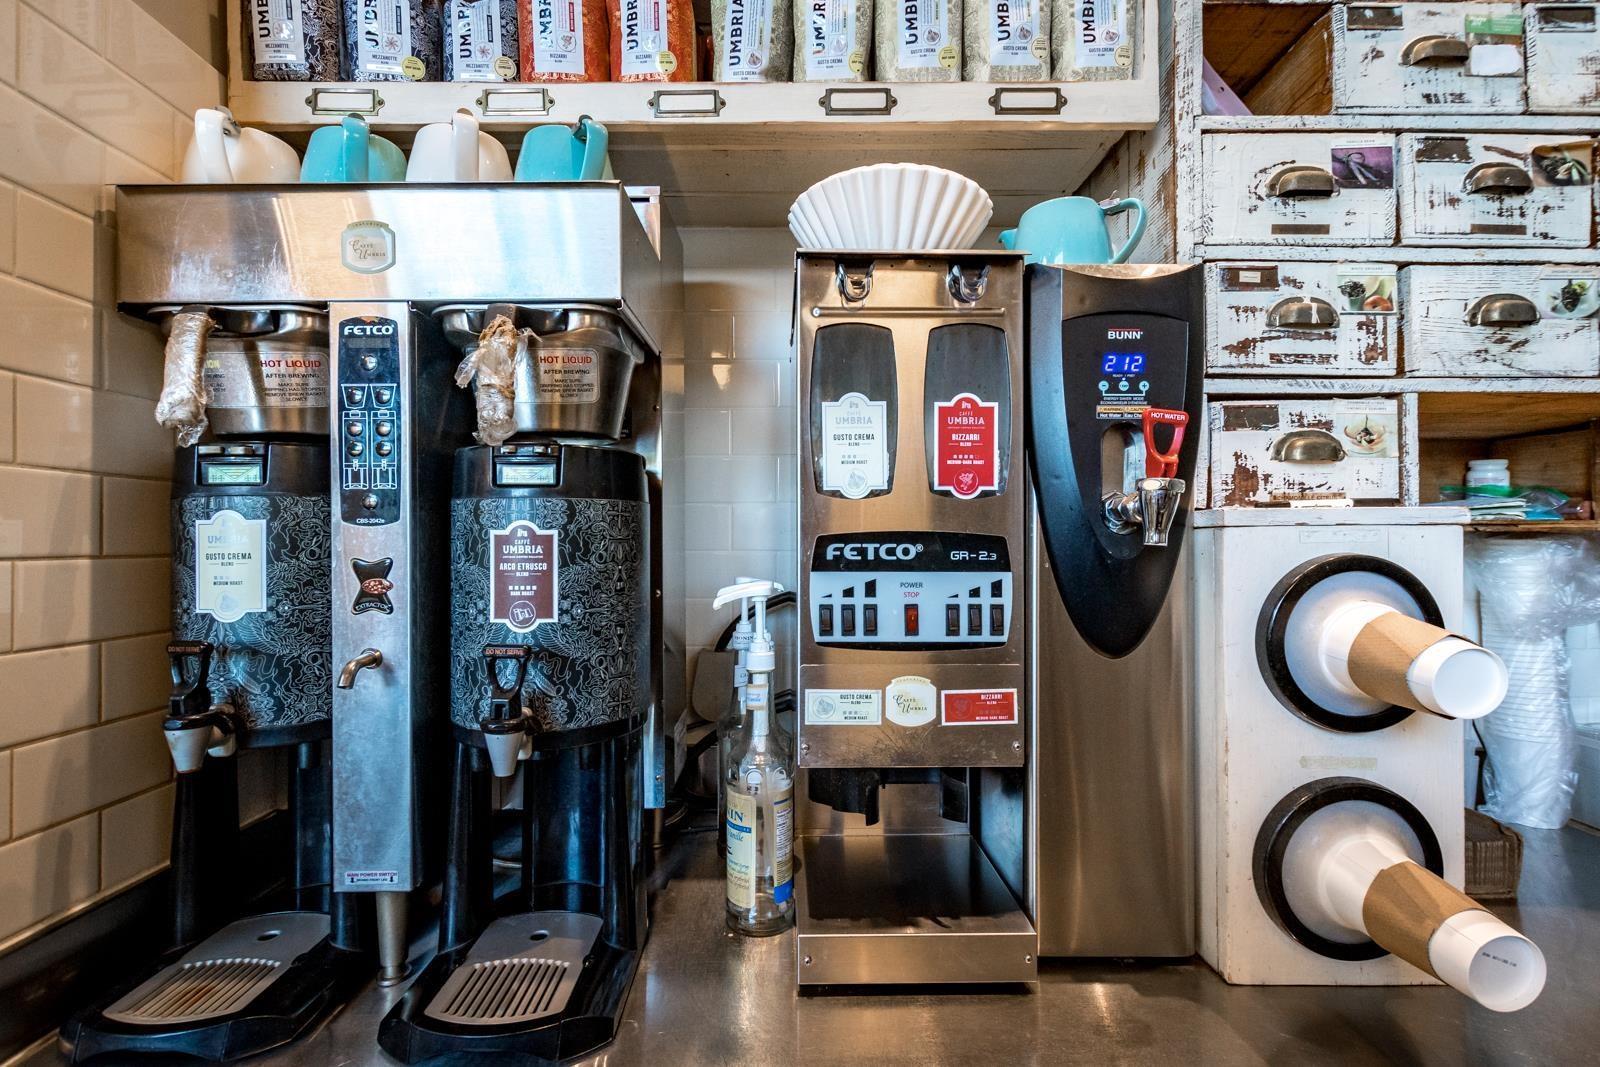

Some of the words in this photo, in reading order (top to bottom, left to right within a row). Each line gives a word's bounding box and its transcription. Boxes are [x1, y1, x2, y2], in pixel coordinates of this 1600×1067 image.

[260, 360, 283, 368] HOT
[285, 360, 321, 368] LIQUID
[540, 356, 559, 364] HOT
[562, 356, 592, 364] LIQUID
[1104, 355, 1143, 372] 212
[835, 416, 873, 425] UMBRIA
[947, 416, 985, 425] UMBRIA
[1151, 411, 1164, 419] HOT
[1164, 412, 1186, 421] WATER
[833, 433, 853, 441] GUSTO
[854, 433, 875, 441] CREMA
[951, 433, 980, 441] BIZZARRI
[502, 545, 543, 554] UMBRIA
[205, 552, 226, 561] GUSTO
[227, 552, 252, 560] CREMA
[499, 562, 516, 570] ARCO
[517, 562, 548, 571] ETRUSCO
